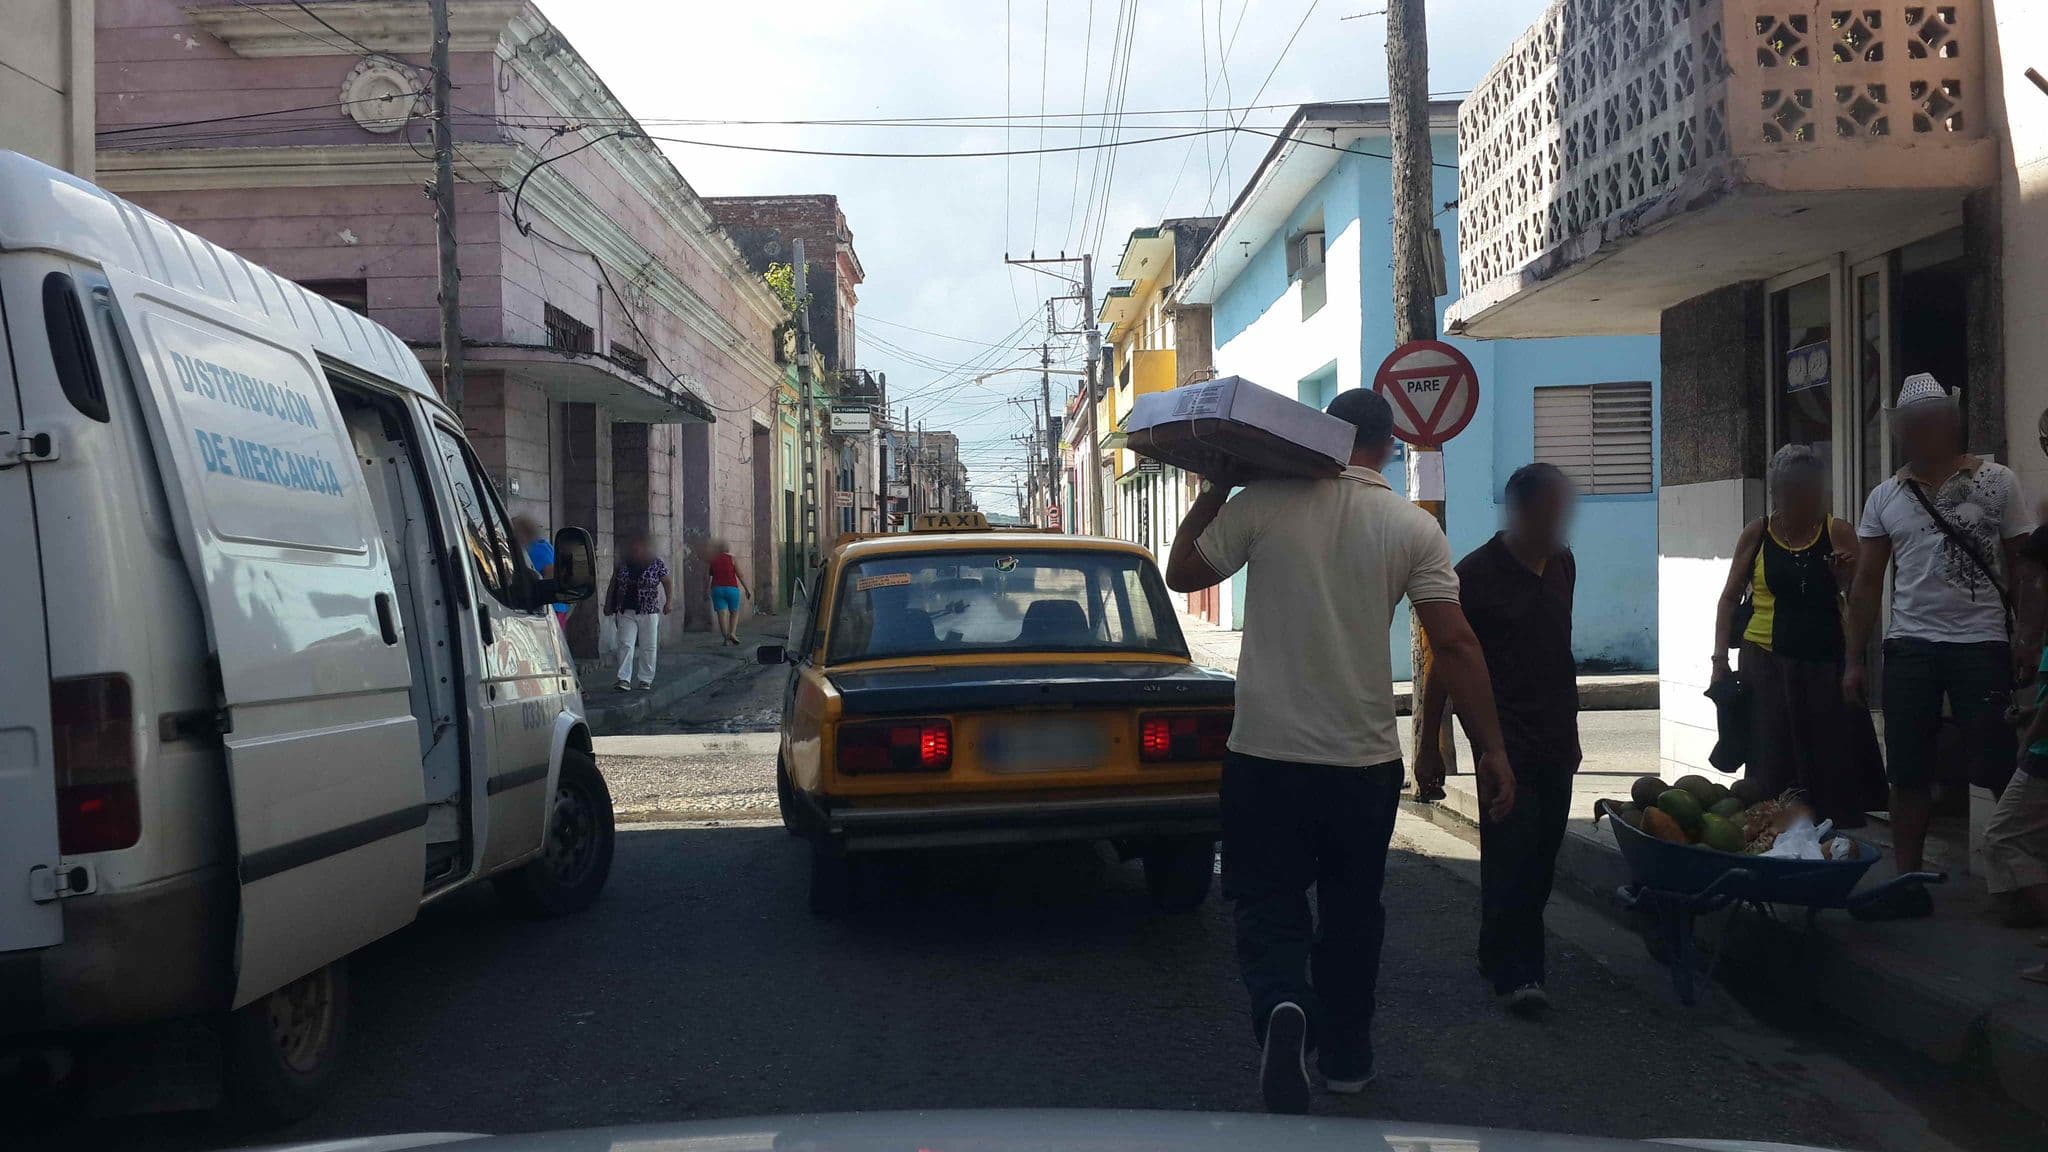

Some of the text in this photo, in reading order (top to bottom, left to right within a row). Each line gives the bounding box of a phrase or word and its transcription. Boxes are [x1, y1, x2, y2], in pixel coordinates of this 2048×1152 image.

[170, 350, 319, 430] DISTRIBUCIÓN
[1407, 379, 1440, 393] PARE
[194, 428, 344, 498] DE MERCANCÍA
[924, 515, 979, 527] TAXI
